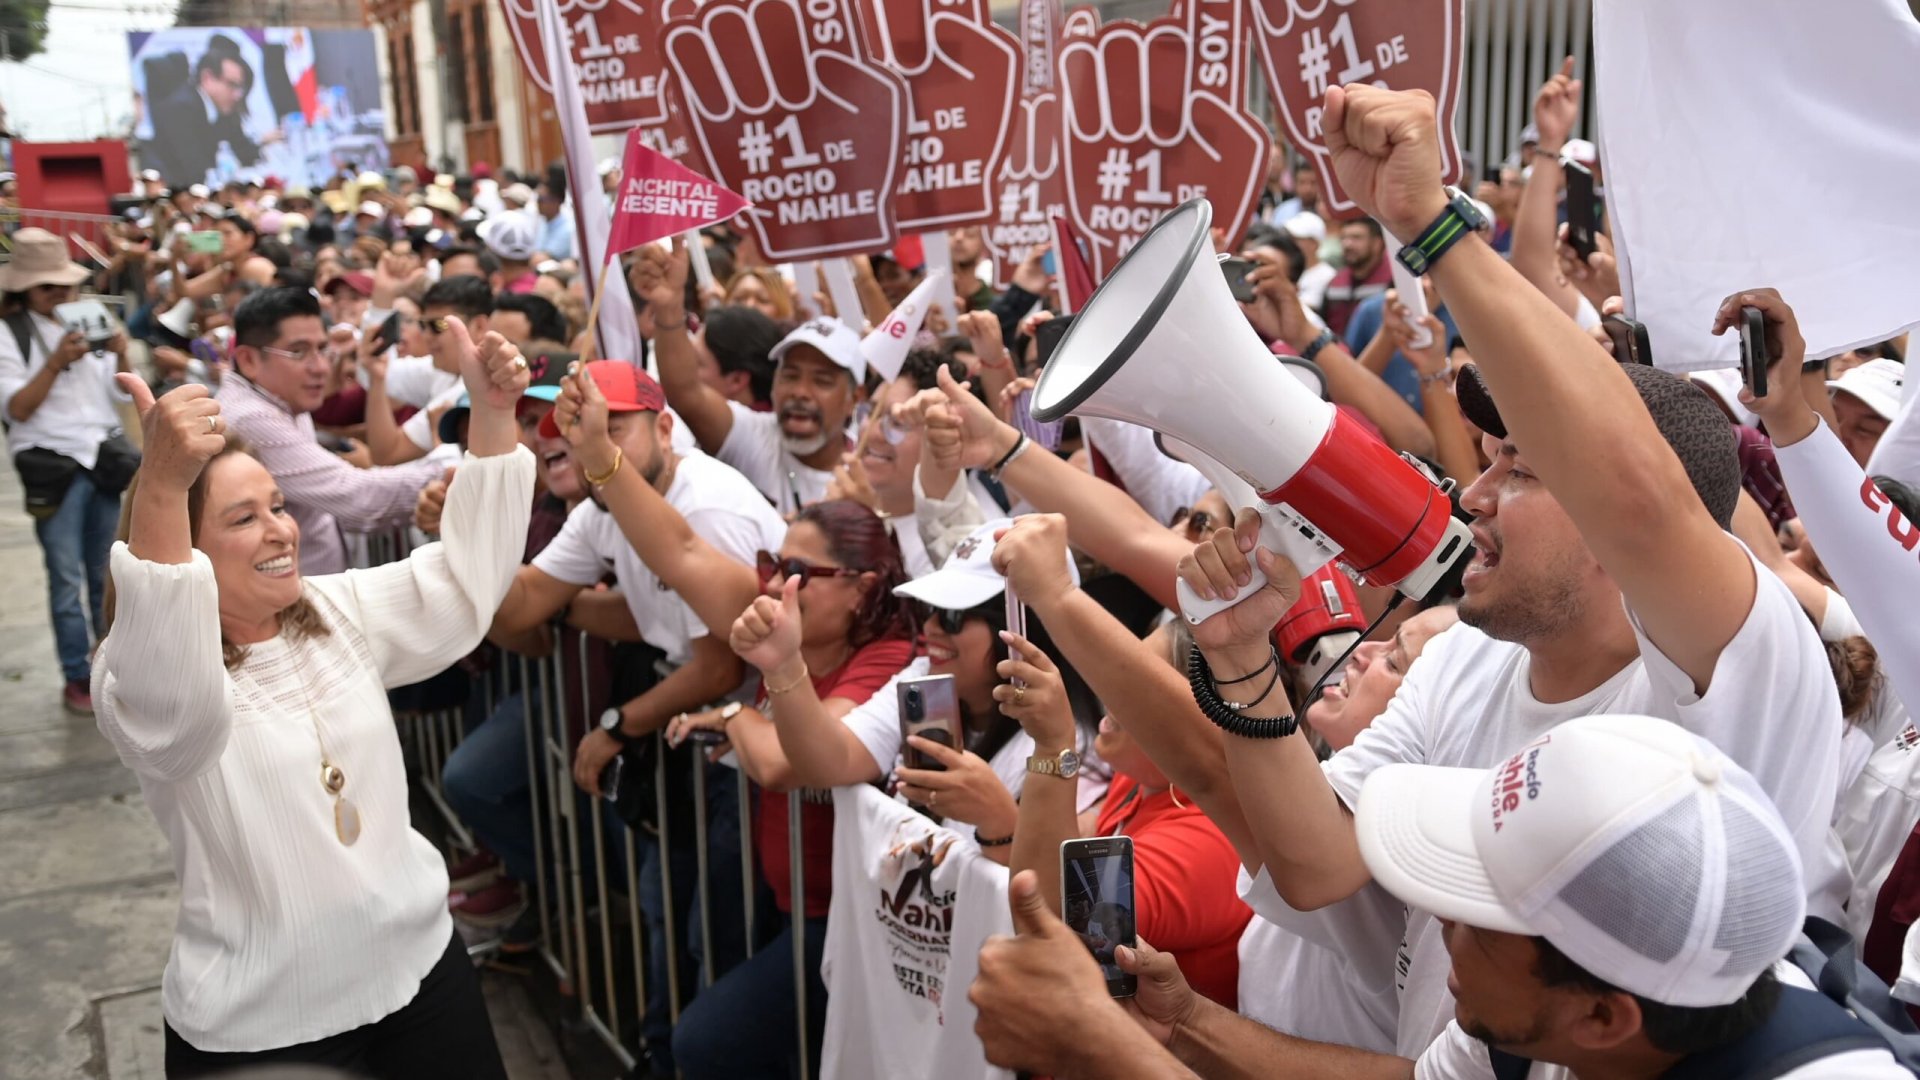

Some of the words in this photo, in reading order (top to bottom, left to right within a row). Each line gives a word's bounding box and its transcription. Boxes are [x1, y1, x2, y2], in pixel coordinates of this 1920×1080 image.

[614, 33, 641, 54] DE
[1199, 12, 1230, 87] SOY
[1299, 12, 1374, 99] #1
[1376, 35, 1409, 70] DE
[934, 107, 967, 131] DE
[738, 114, 821, 174] #1
[823, 139, 857, 163] DE
[627, 178, 718, 200] NCHITAL
[742, 168, 836, 202] ROCIO
[897, 160, 982, 194] AHLE
[1097, 147, 1173, 204] #1
[622, 194, 718, 219] ESENTE
[778, 189, 876, 226] NAHLE
